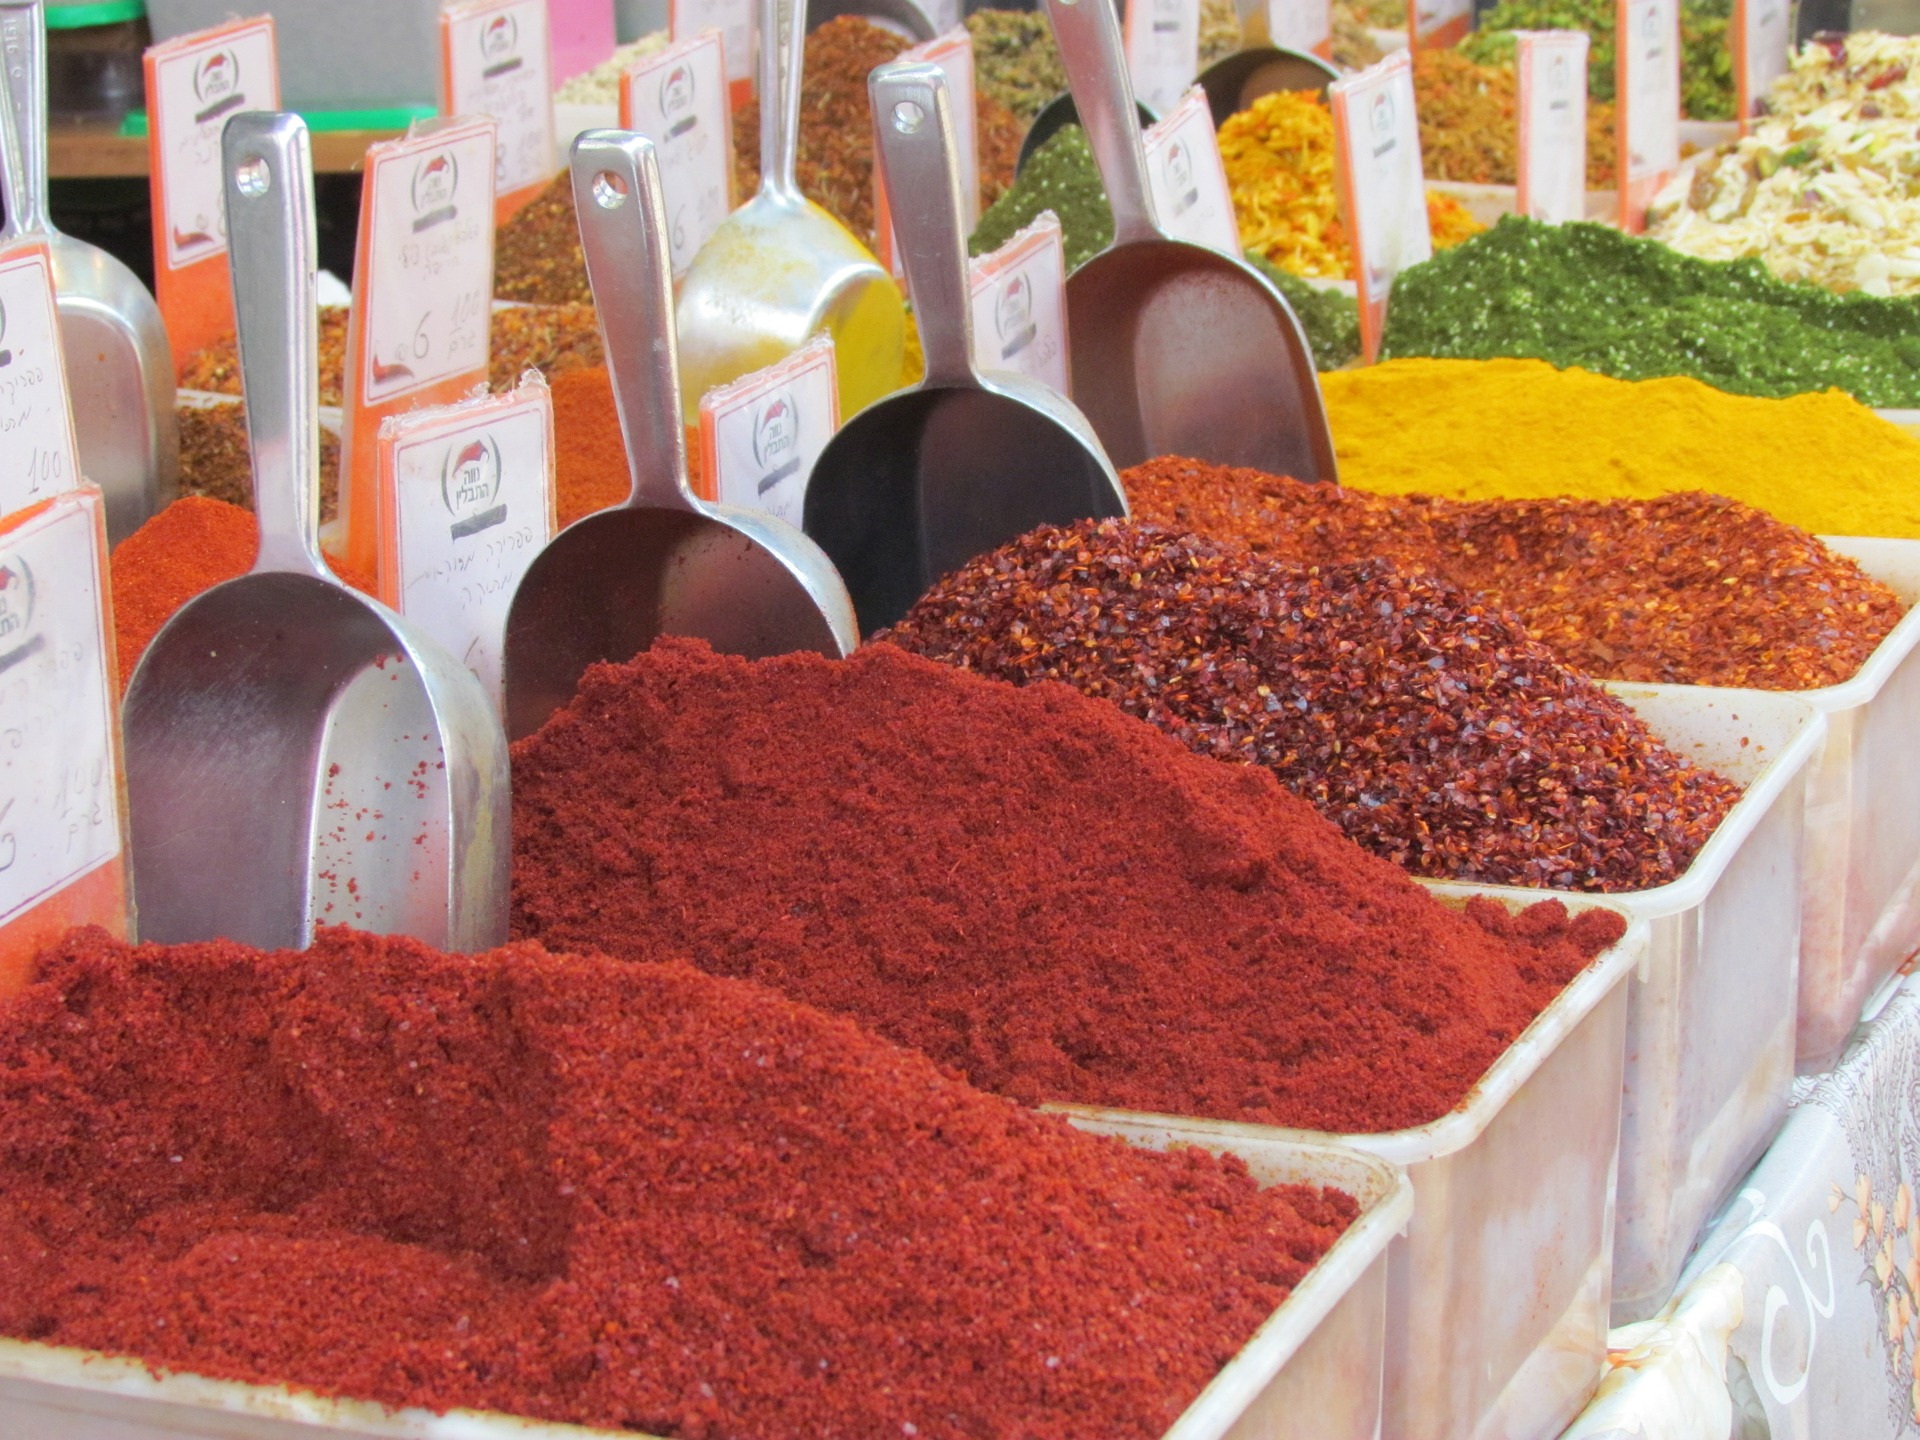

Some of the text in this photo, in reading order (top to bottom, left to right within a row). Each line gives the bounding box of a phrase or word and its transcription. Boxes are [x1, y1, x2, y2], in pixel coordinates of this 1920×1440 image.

[413, 310, 432, 359] 6
[28, 446, 61, 495] 100
[455, 482, 490, 511] התבלין
